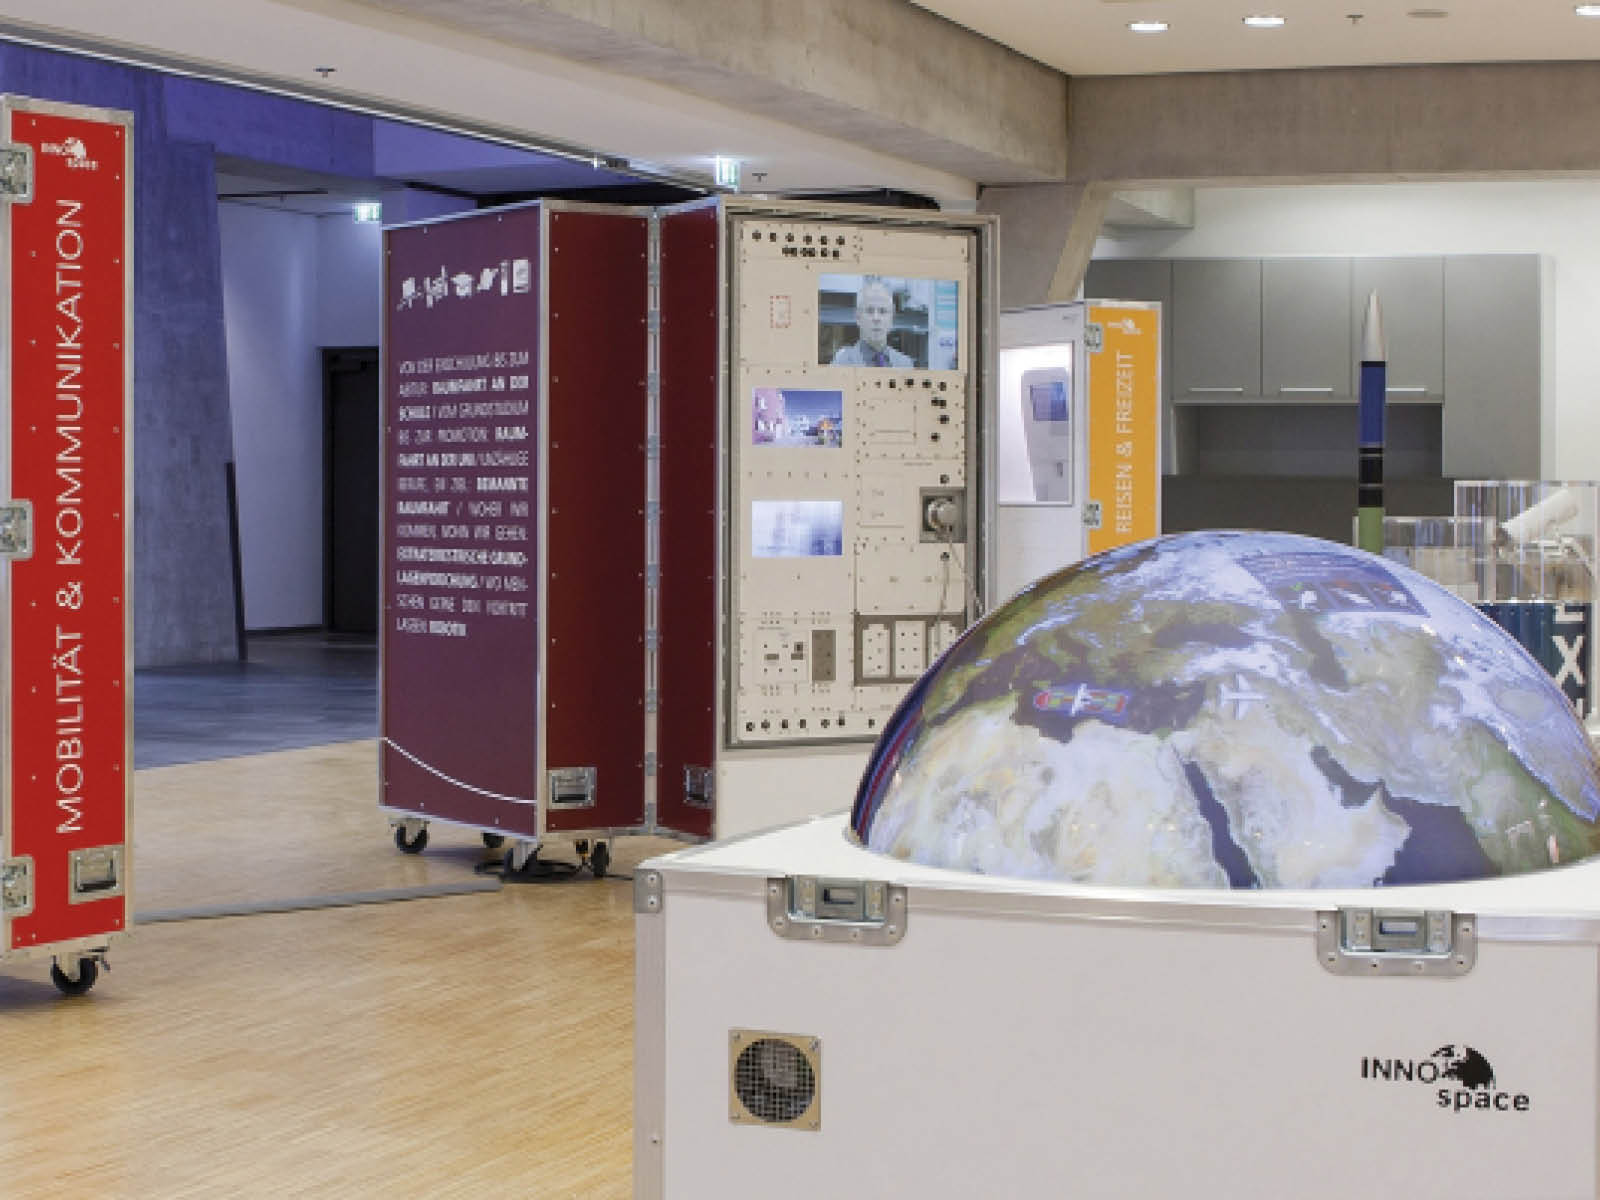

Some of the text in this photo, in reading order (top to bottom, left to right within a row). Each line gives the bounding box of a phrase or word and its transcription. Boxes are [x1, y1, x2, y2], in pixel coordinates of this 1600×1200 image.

[1116, 350, 1134, 435] FREIZEIT
[52, 199, 83, 834] MOBILITÄT & KOMMUNIKATION
[1116, 464, 1133, 534] REISEN
[1360, 1056, 1439, 1084] INNO
[1436, 1088, 1531, 1114] space
